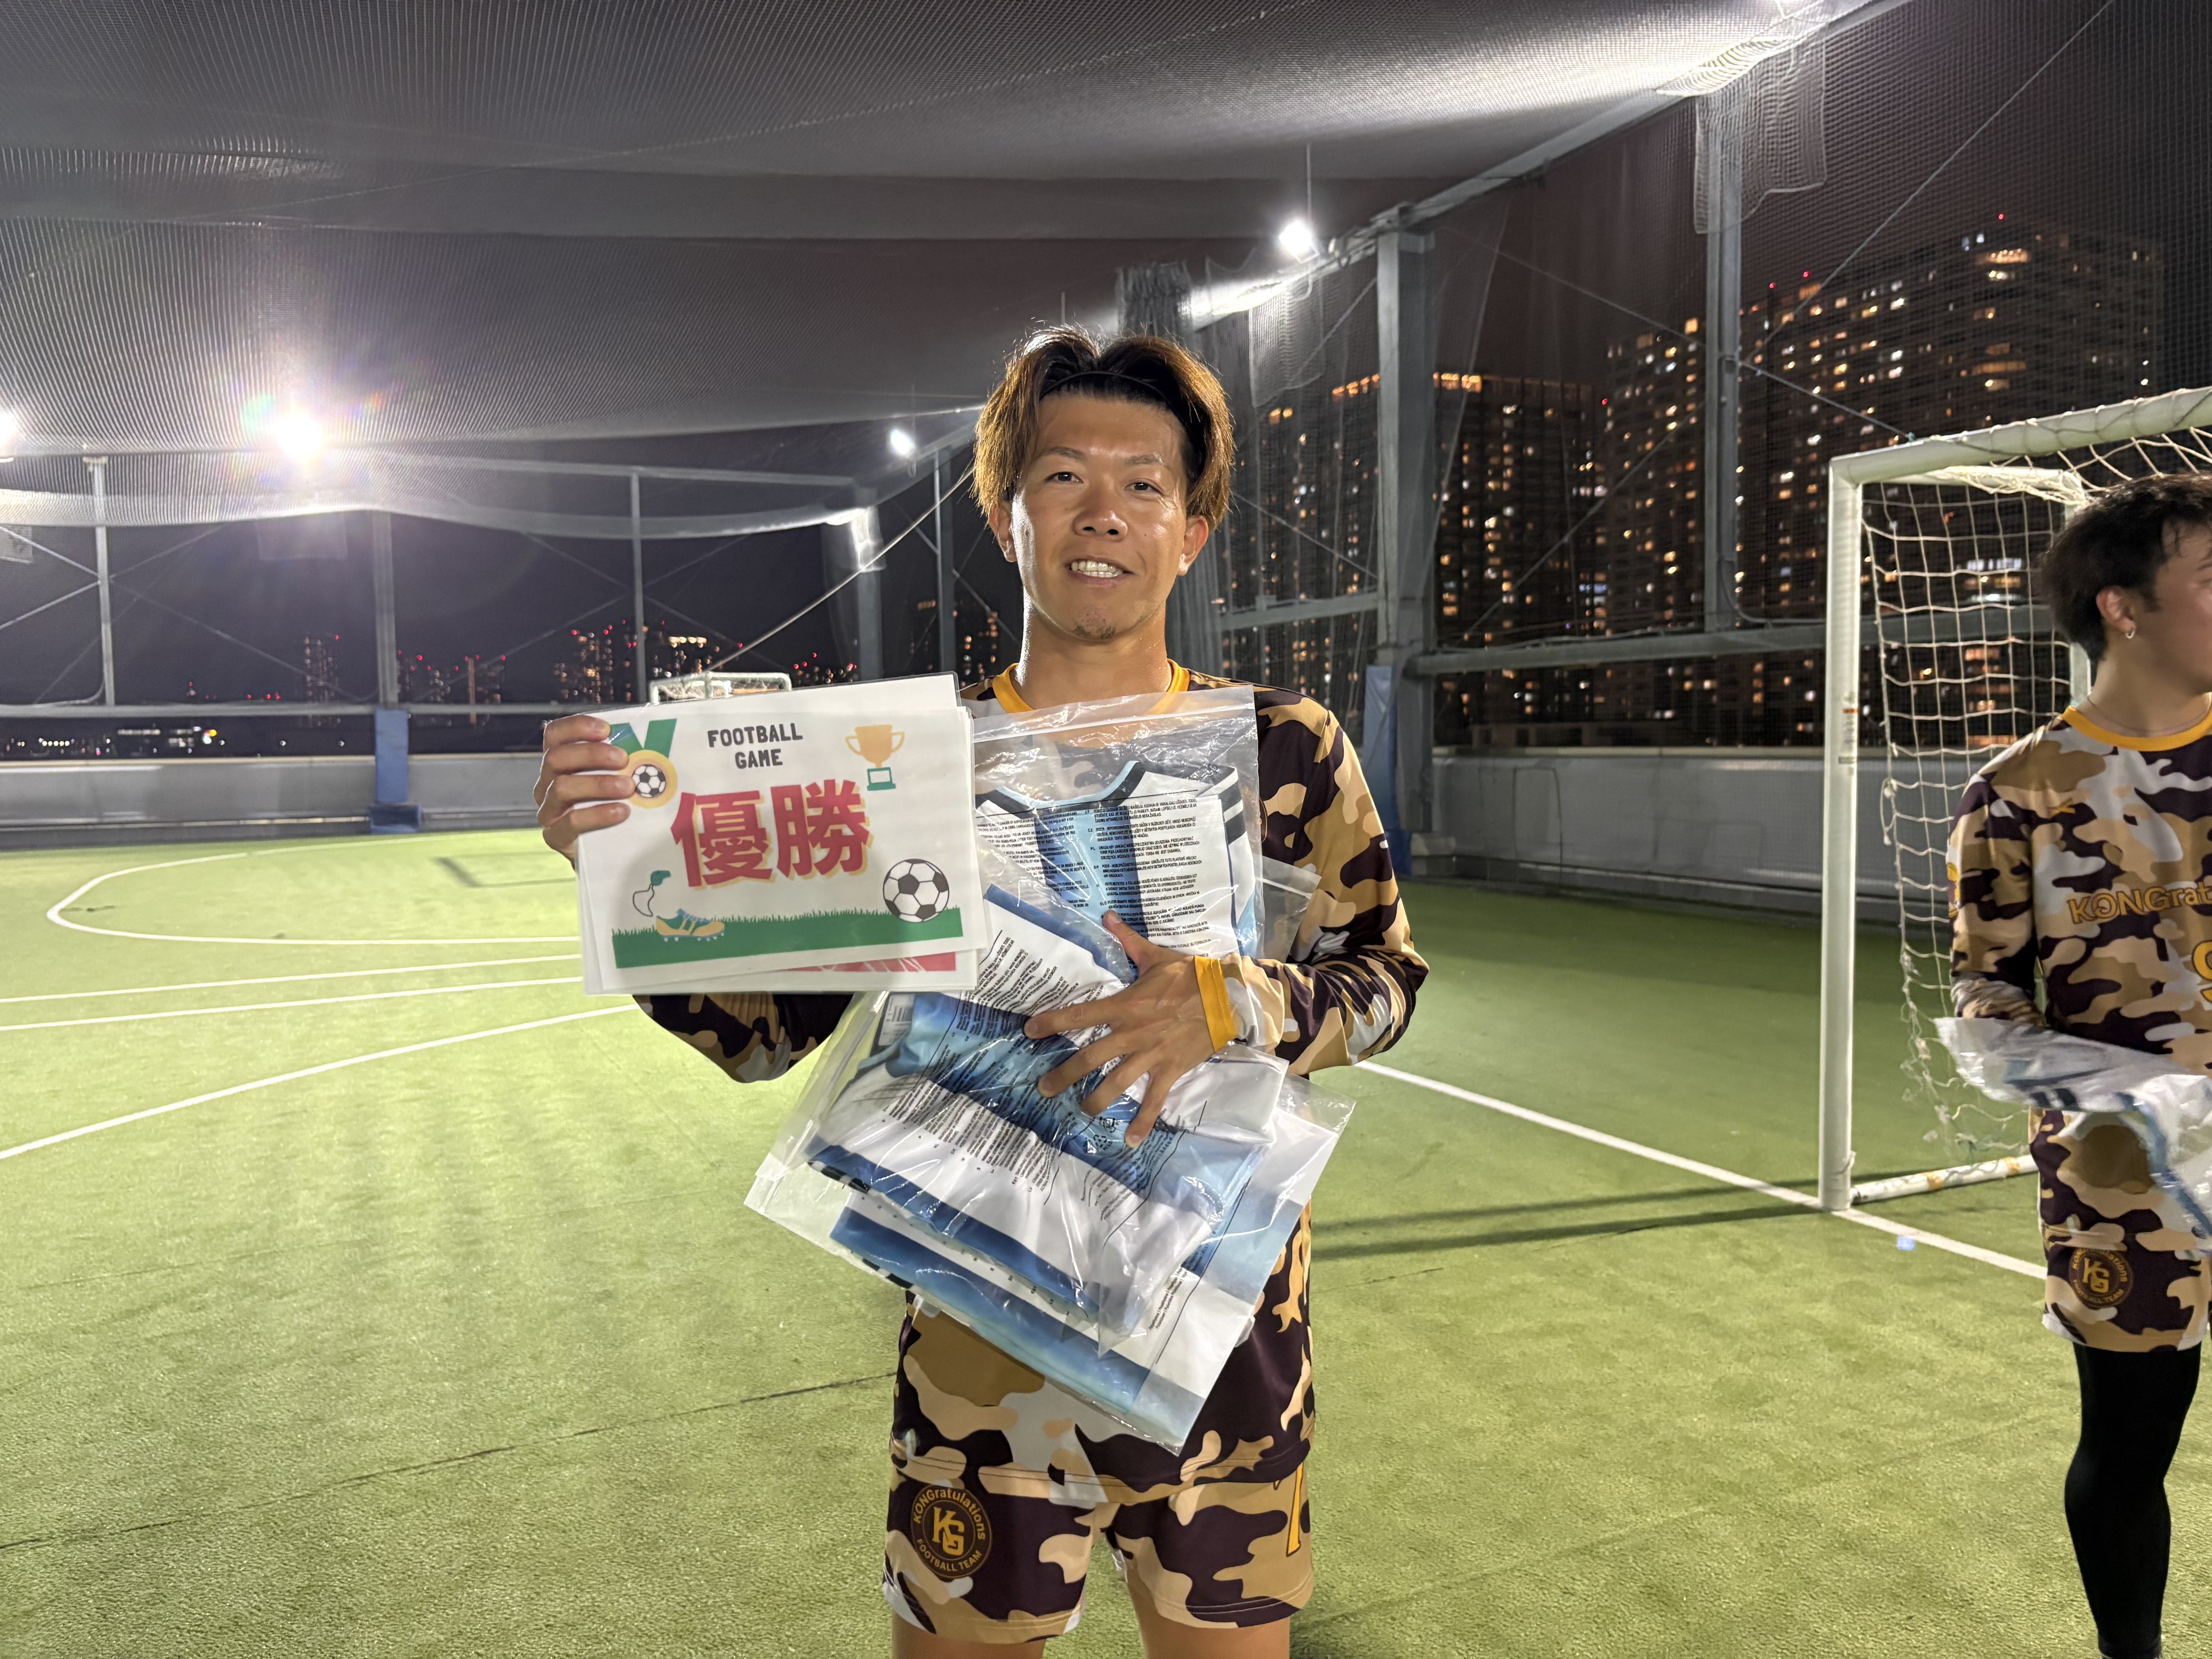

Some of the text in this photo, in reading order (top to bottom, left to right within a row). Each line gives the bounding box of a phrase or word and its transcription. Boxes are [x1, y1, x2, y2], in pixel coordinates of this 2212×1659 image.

[708, 723, 803, 747] FOOTBALL
[735, 749, 783, 769] GAME
[671, 779, 874, 890] 優勝
[913, 1488, 986, 1540] KONGratulations
[916, 1538, 982, 1571] FOOTBALL TEAM
